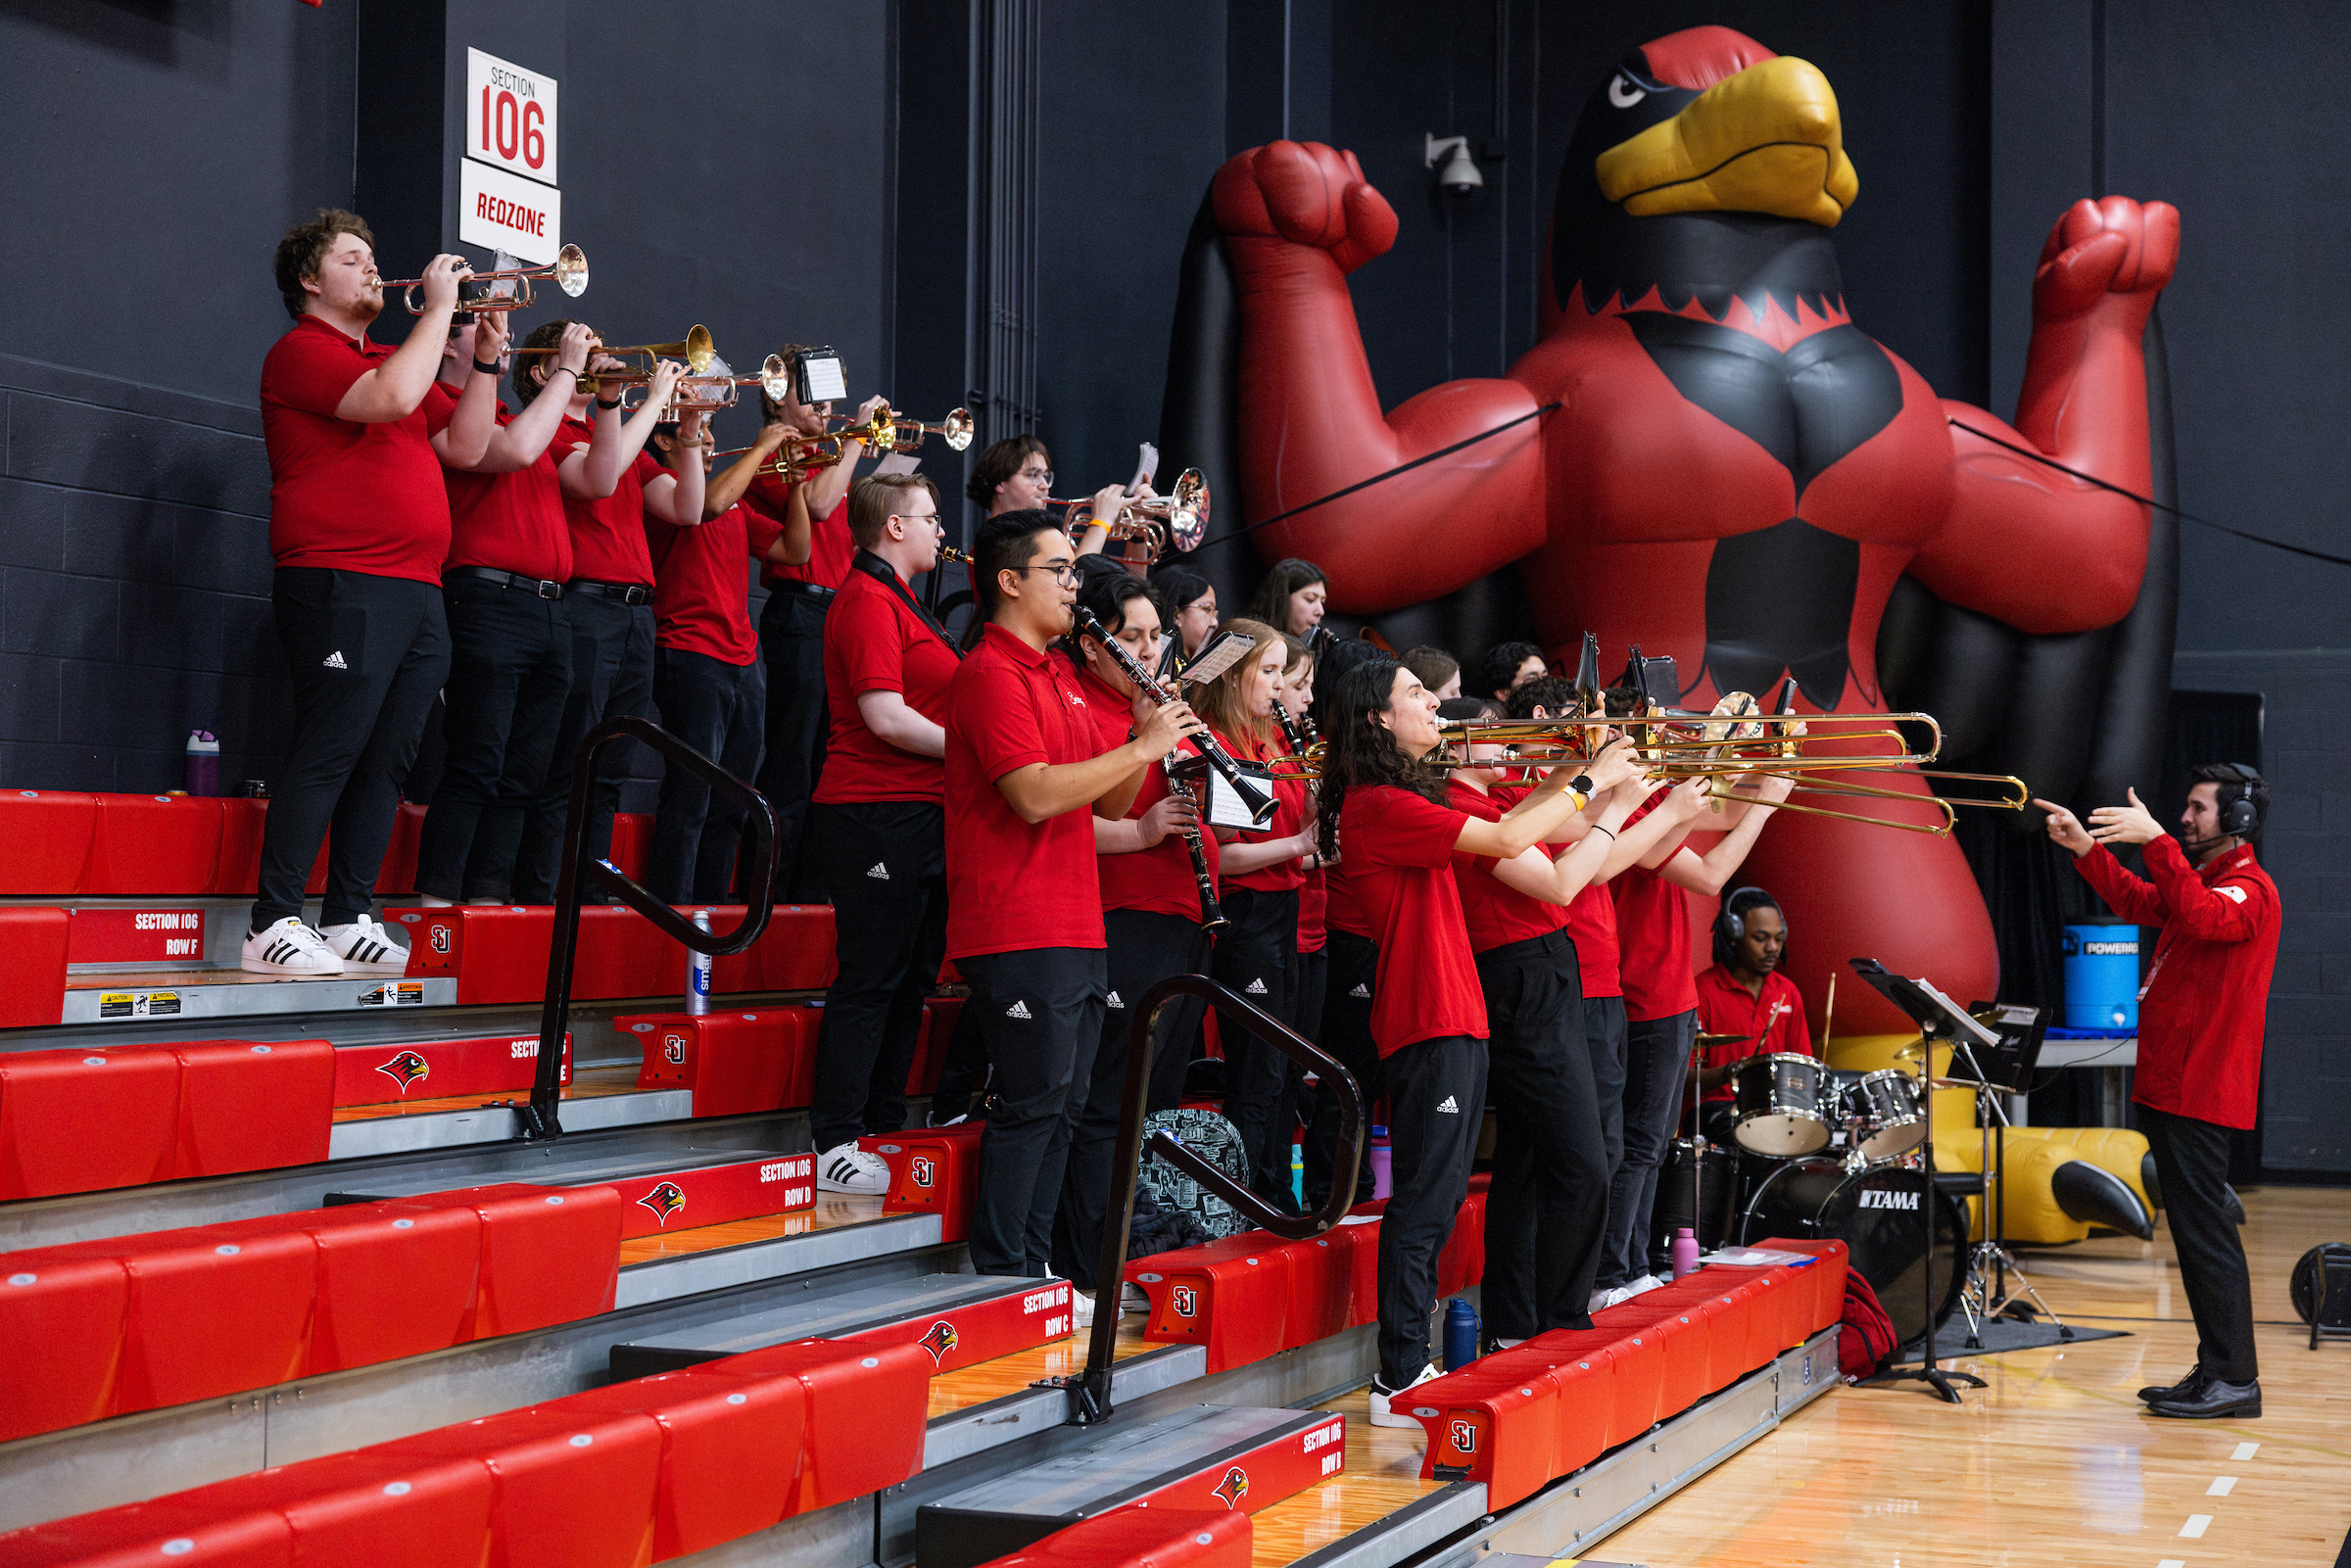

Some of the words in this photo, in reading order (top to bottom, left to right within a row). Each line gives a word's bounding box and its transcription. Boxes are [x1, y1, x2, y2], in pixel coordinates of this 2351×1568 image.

[491, 67, 535, 99] SECTION
[482, 84, 545, 170] 106
[476, 191, 546, 238] REDZONE
[135, 913, 179, 930] SECTION
[181, 913, 199, 929] 106
[166, 938, 190, 955] ROW
[191, 938, 198, 955] F
[511, 1039, 540, 1059] SECTI
[760, 1162, 796, 1183] SECTION
[797, 1158, 811, 1177] 106
[912, 1157, 936, 1188] SU
[785, 1187, 804, 1207] ROW
[804, 1186, 811, 1204] D
[1870, 1190, 1920, 1211] TAMA
[1024, 1289, 1055, 1314] SECTION
[1056, 1286, 1069, 1307] 106
[1173, 1285, 1198, 1317] SU
[1045, 1316, 1063, 1338] ROW
[1063, 1313, 1069, 1332] C
[1304, 1425, 1330, 1454] SECTION
[1330, 1421, 1341, 1443] 106
[1451, 1419, 1478, 1453] SU
[1321, 1452, 1336, 1476] ROW
[1336, 1450, 1341, 1470] B
